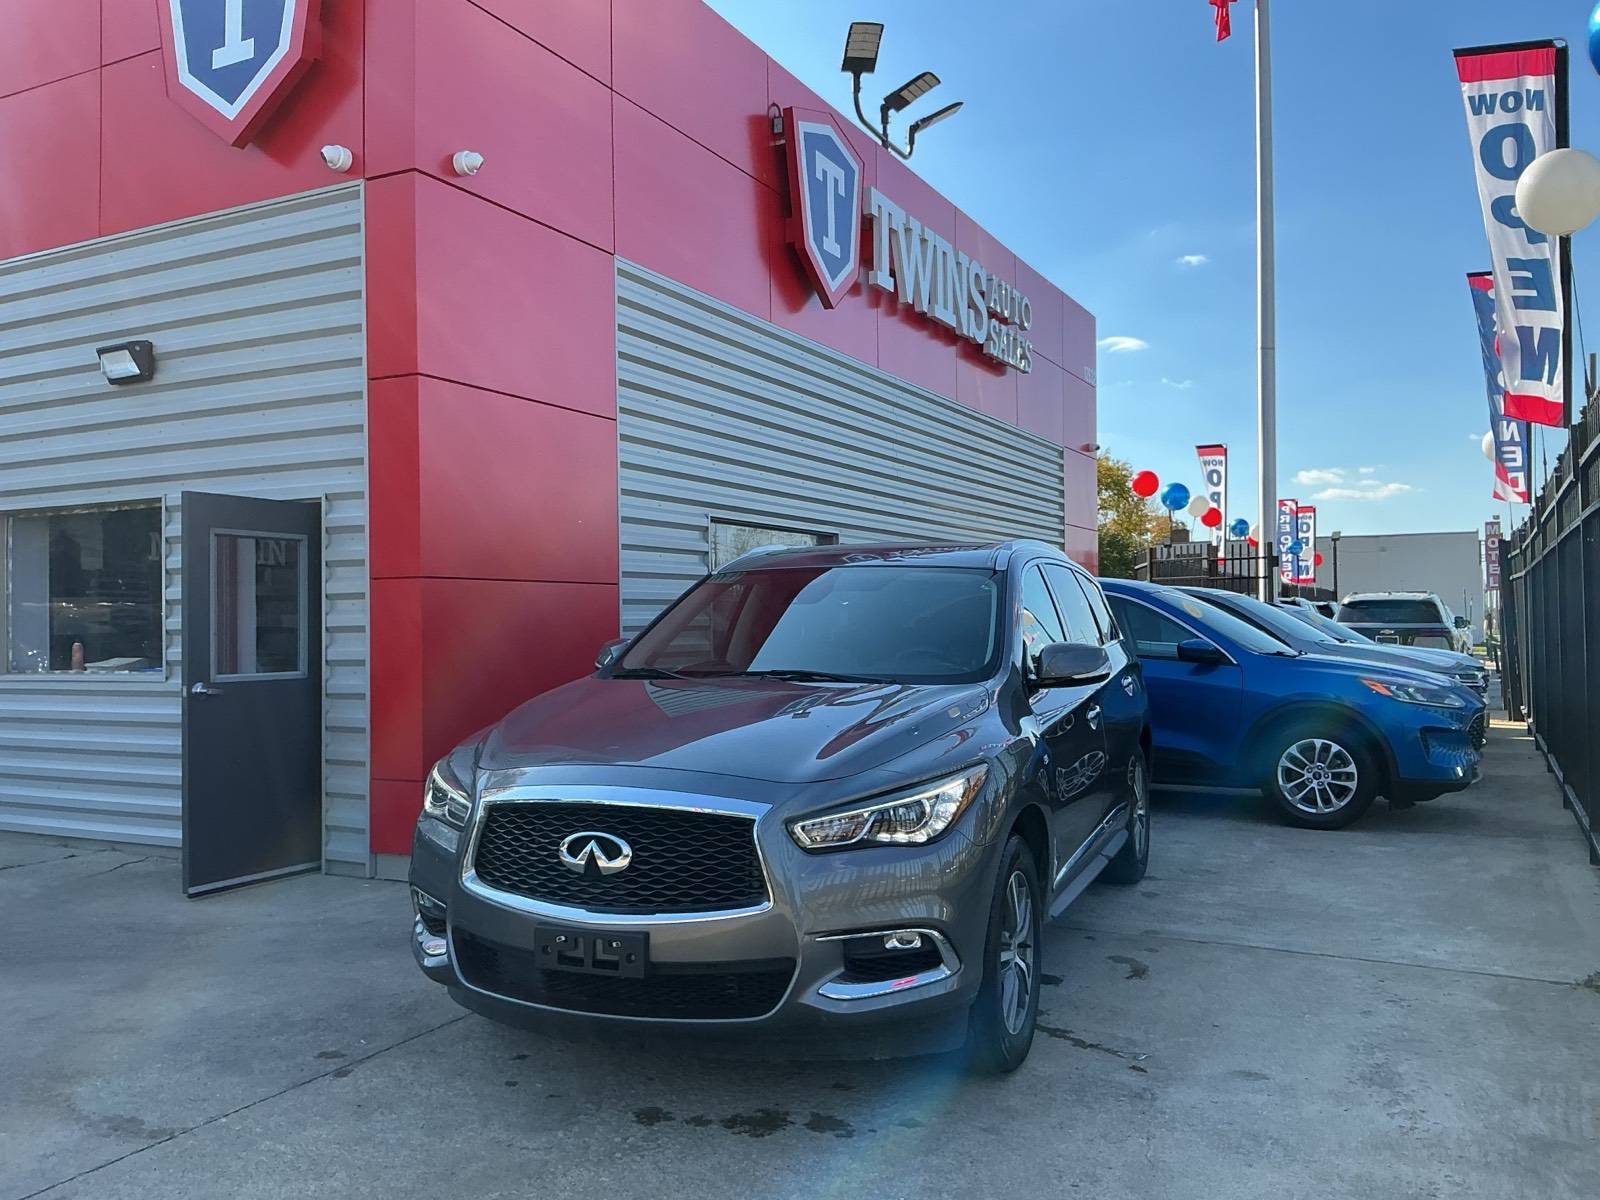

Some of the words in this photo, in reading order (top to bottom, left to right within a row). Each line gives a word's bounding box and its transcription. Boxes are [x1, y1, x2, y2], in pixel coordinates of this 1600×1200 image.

[815, 150, 846, 258] T
[863, 187, 987, 344] TWINS
[988, 274, 1033, 332] AUTO
[984, 318, 1033, 374] SALES
[1487, 524, 1500, 587] MOTEL
